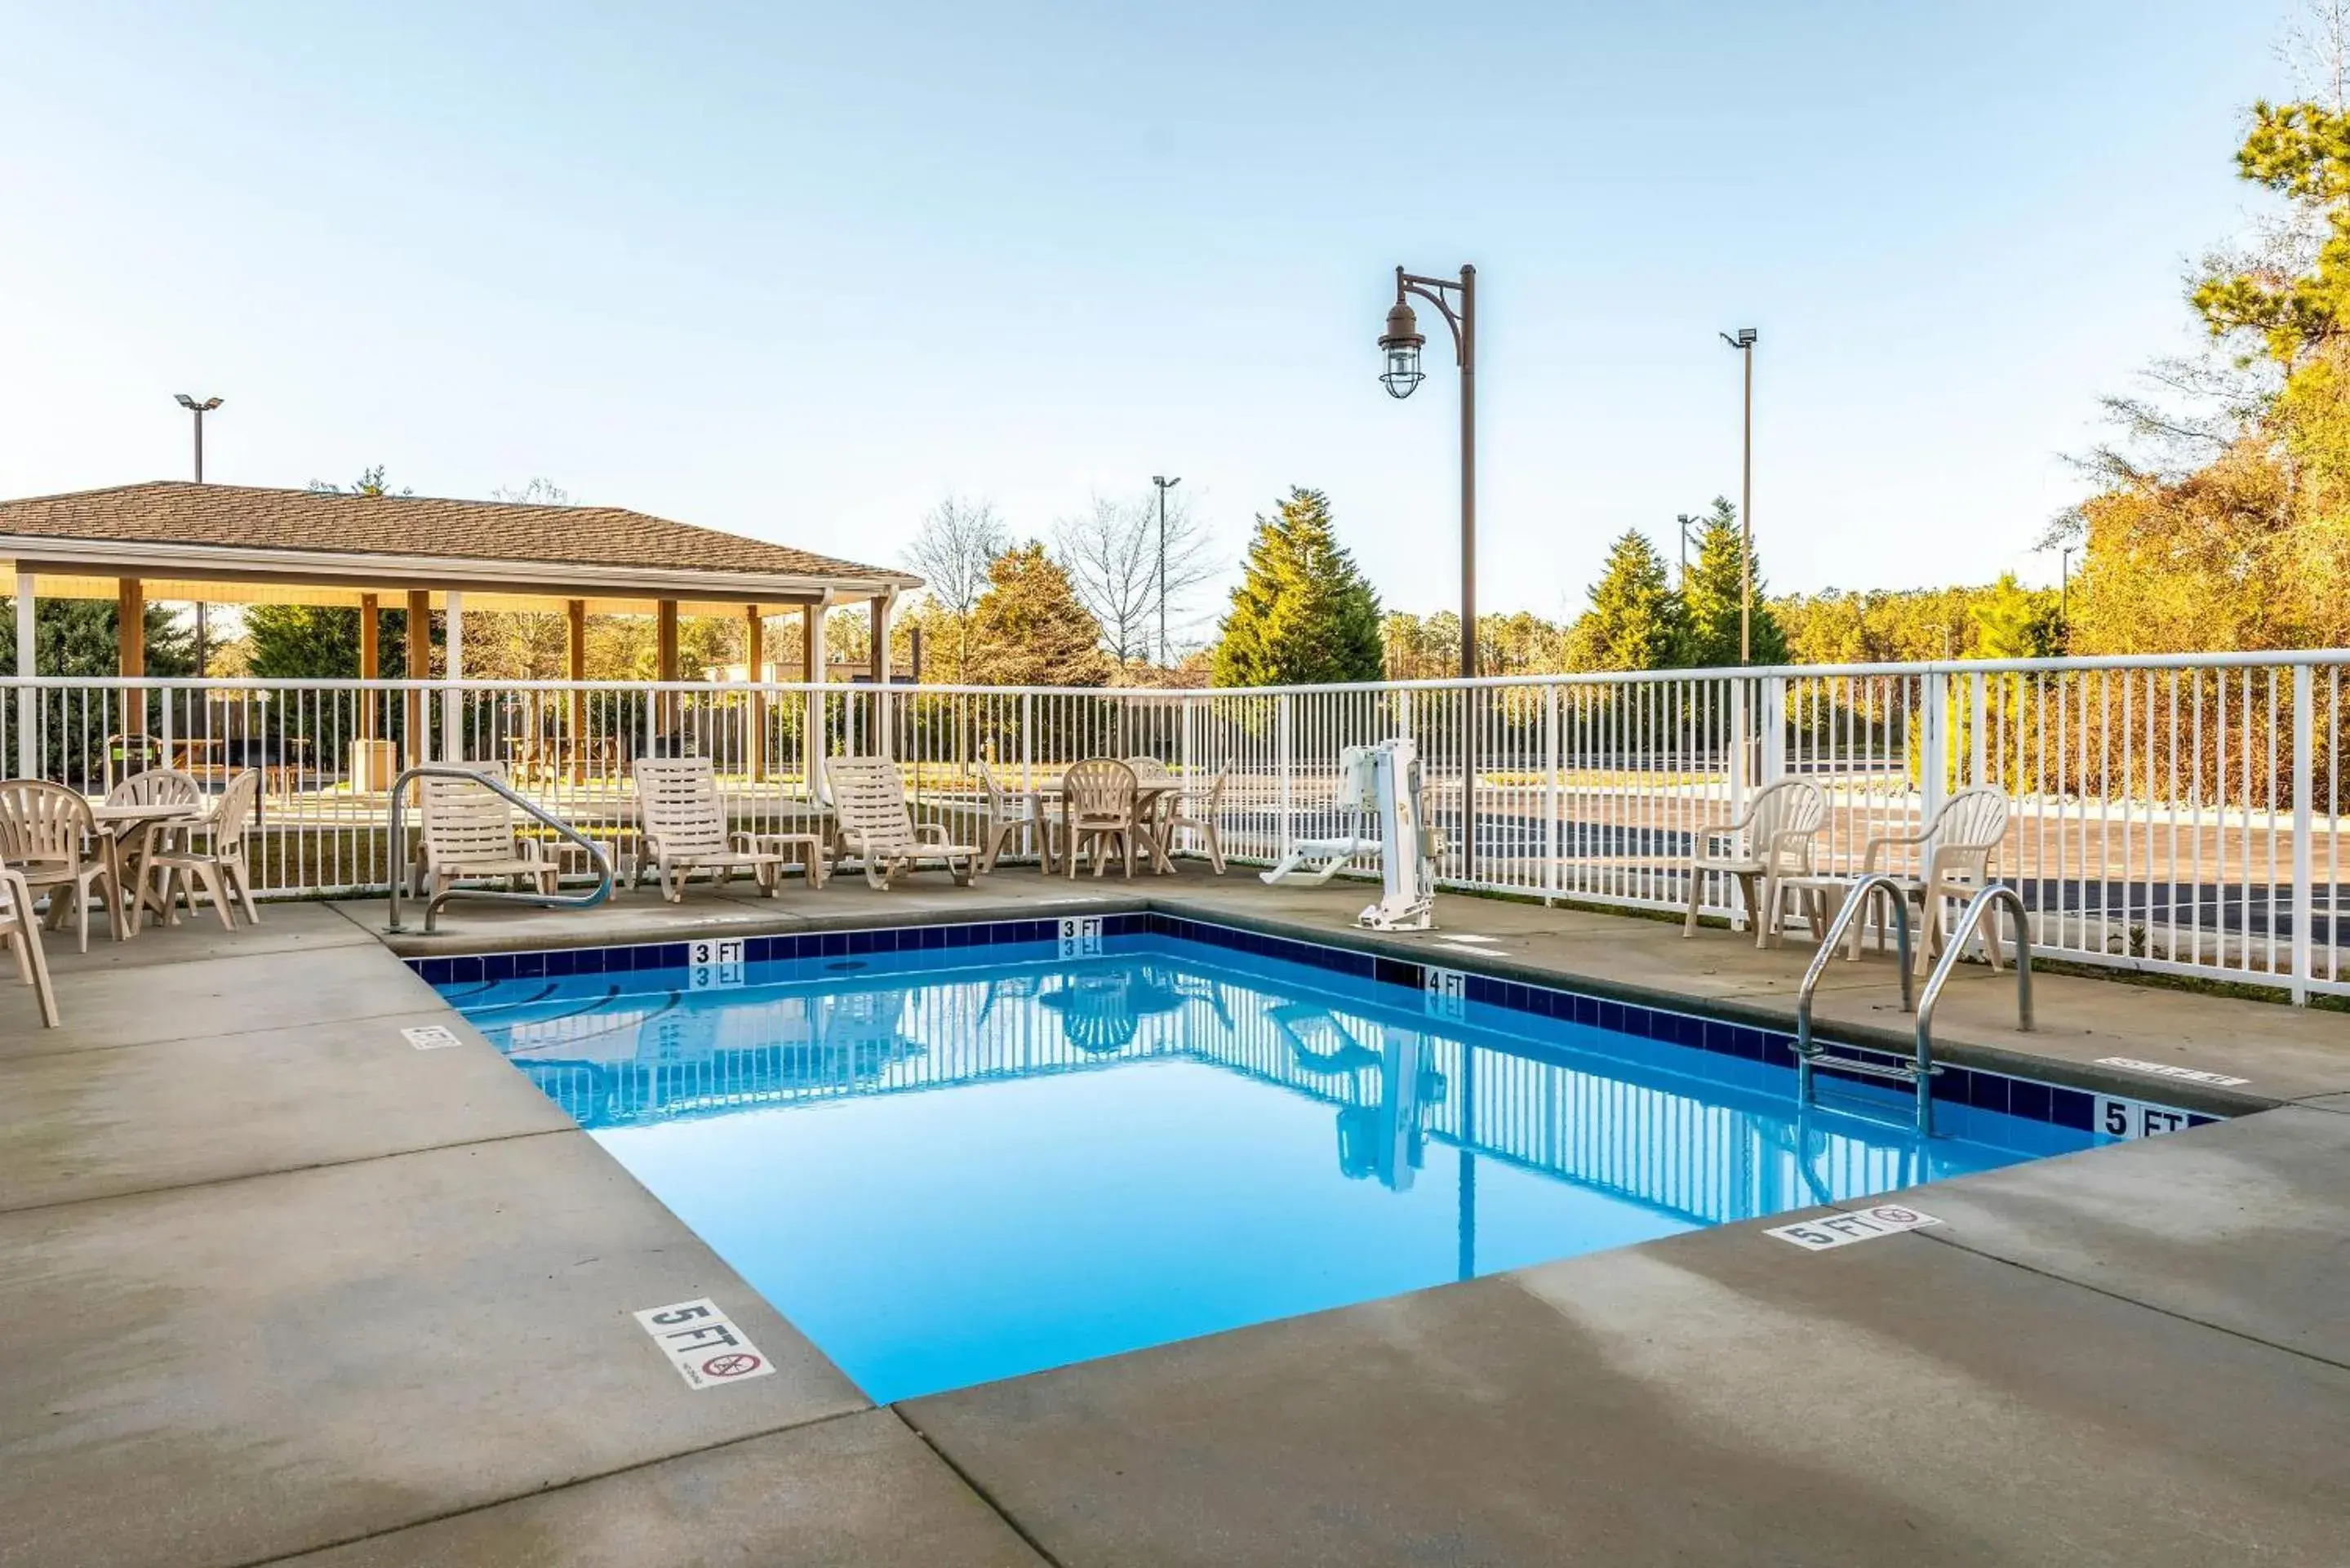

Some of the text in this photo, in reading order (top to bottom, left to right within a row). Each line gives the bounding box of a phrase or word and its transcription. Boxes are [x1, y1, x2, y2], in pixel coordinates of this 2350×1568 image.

[1064, 919, 1100, 938] 3 FT
[696, 942, 741, 964] 3 FT
[1430, 971, 1463, 998] 4 FT
[2105, 1101, 2183, 1137] 5 FT
[1784, 1216, 1884, 1244] 5 FT
[651, 1305, 740, 1353] 5 FT
